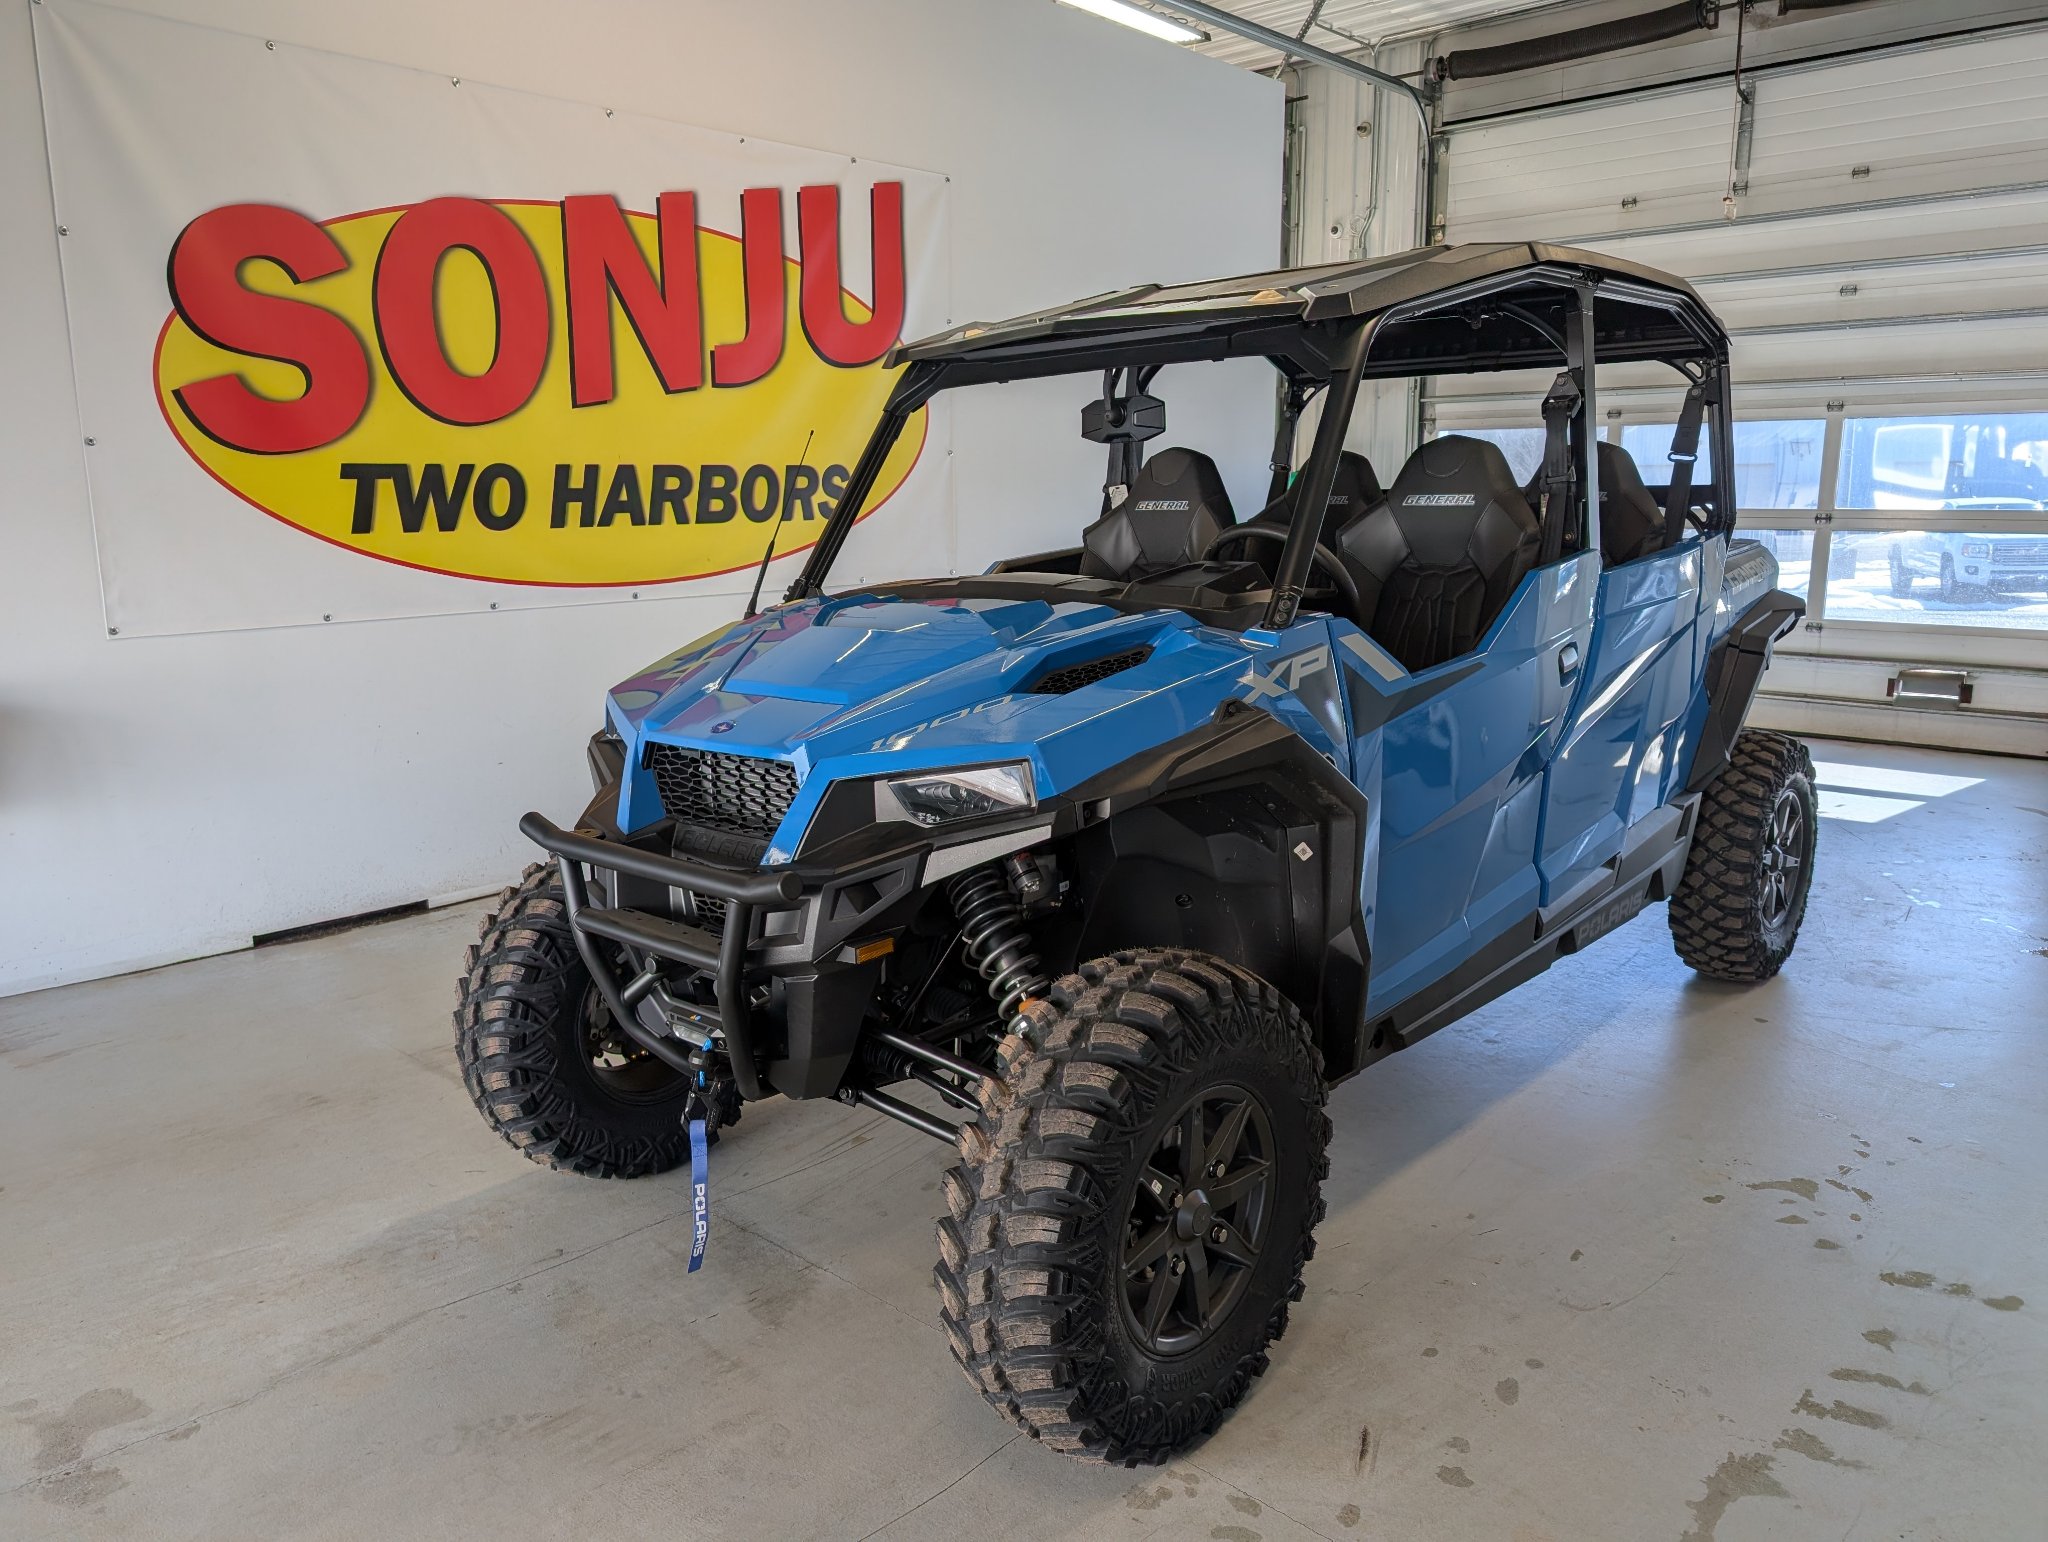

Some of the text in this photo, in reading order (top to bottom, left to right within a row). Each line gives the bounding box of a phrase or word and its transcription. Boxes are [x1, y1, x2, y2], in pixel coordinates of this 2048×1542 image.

[167, 181, 906, 455] SONJU
[340, 463, 850, 534] TWO HARBORS
[1135, 500, 1189, 511] GENERAL
[1402, 494, 1475, 506] GENERAL
[1236, 644, 1329, 704] XP
[870, 694, 1013, 751] 1000
[1577, 889, 1644, 945] POLARIS
[692, 1183, 707, 1258] POLARIS
